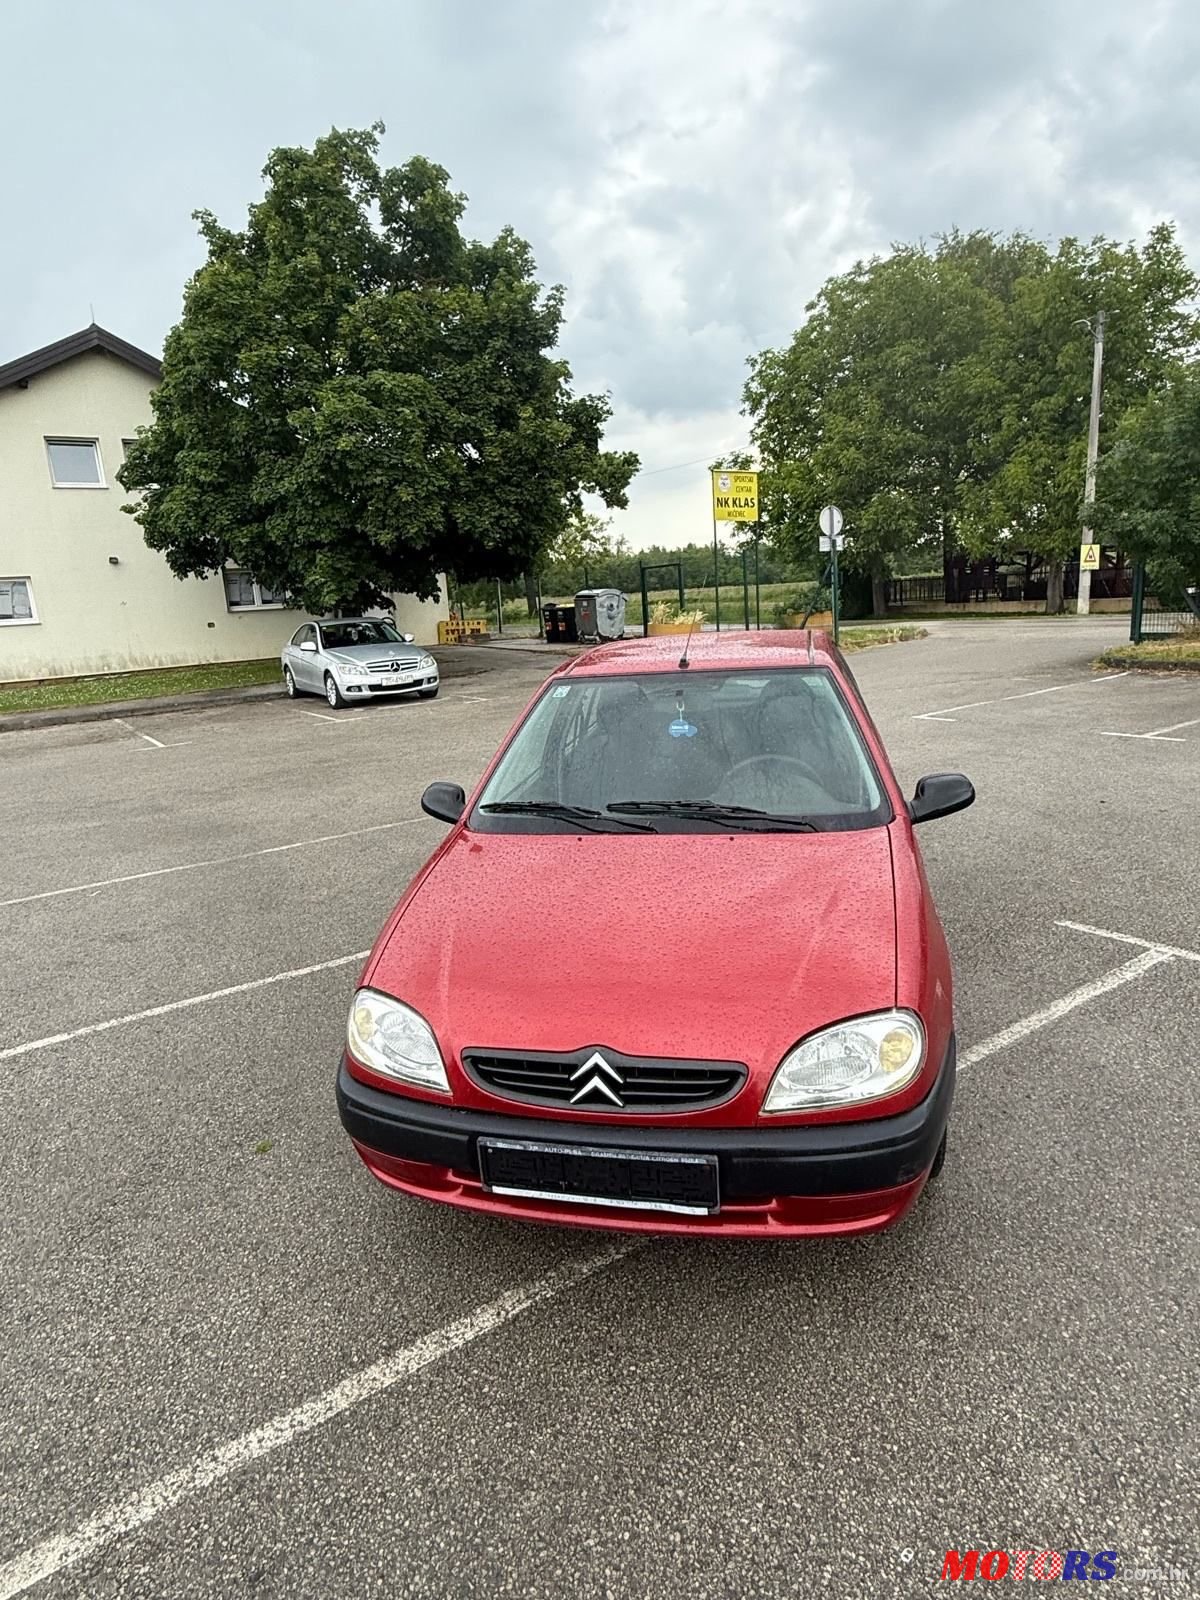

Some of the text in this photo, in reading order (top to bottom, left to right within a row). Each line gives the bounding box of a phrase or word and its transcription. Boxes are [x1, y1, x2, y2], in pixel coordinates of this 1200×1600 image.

[735, 485, 752, 493] CENTAR
[716, 496, 755, 508] NK KLAS
